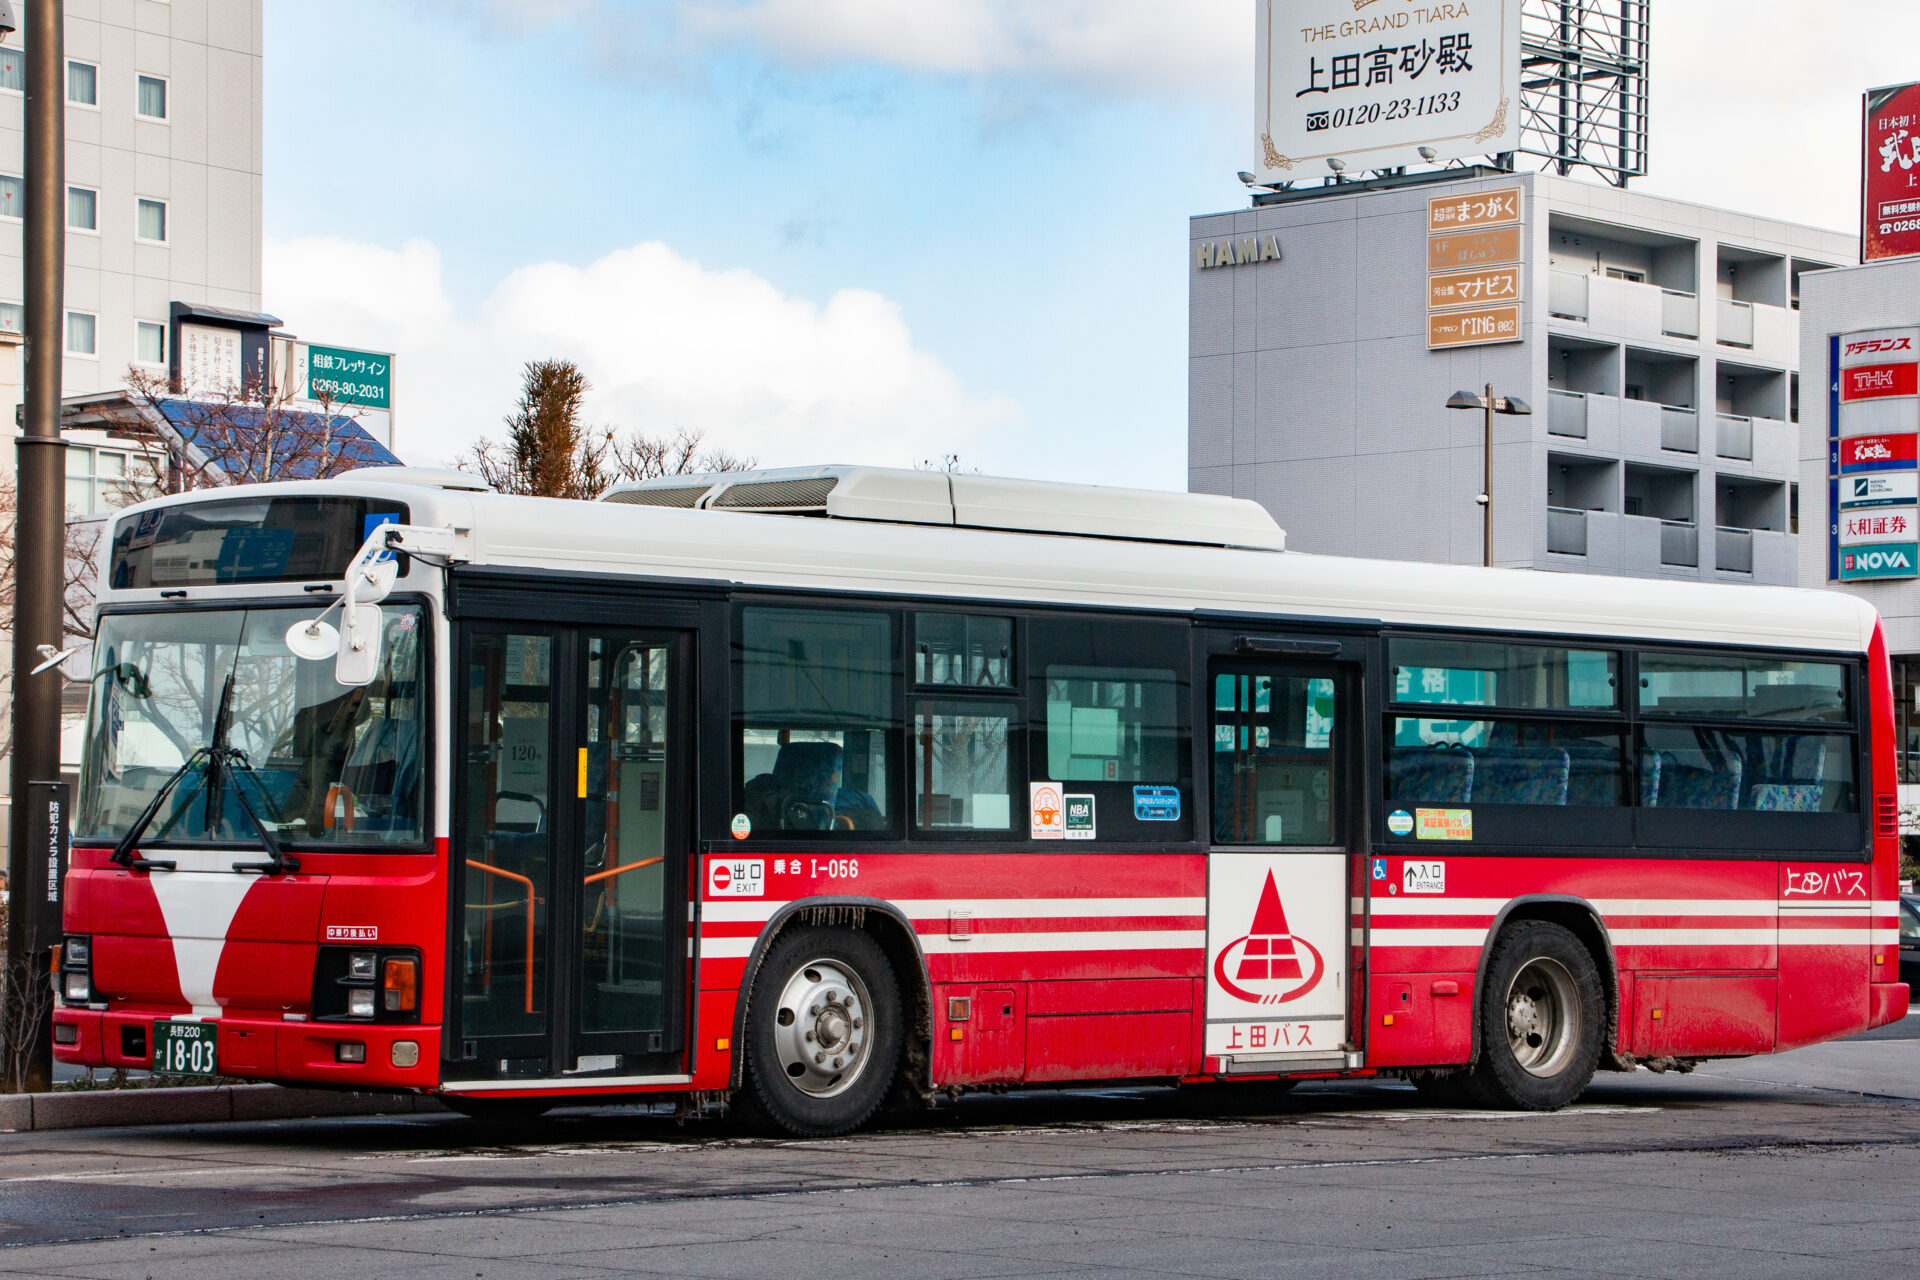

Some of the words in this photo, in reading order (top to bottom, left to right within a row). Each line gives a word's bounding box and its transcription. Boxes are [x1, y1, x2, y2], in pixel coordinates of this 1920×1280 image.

[1301, 24, 1336, 43] THE
[1340, 14, 1412, 38] GRAND
[1414, 4, 1469, 25] TIARA
[1296, 33, 1472, 98] 上田高砂殿
[1333, 91, 1461, 129] 0120-23-1133
[1878, 114, 1920, 131] 日本初！
[1905, 173, 1918, 188] 上
[1456, 197, 1515, 222] まつがく
[1197, 236, 1282, 268] HAMA
[1456, 275, 1515, 298] マナビス
[1497, 319, 1515, 332] 002
[1845, 337, 1912, 356] アデランス
[312, 353, 386, 376] 相鉄フレッサイン
[312, 378, 384, 399] 0268-80-2031
[1832, 382, 1838, 392] 4
[1854, 370, 1893, 388] THK
[1832, 453, 1838, 463] 3
[1832, 525, 1838, 534] 3
[1846, 516, 1907, 537] 大和証券
[1857, 552, 1911, 571] NOVA
[1069, 804, 1089, 816] NBA
[48, 801, 60, 902] 防犯カメラ設置区域
[733, 863, 761, 880] 出口
[774, 859, 802, 875] 乗合
[811, 859, 859, 878] I-056
[1420, 865, 1440, 879] 入口
[736, 883, 757, 892] EXIT
[1416, 881, 1444, 890] ENTRANCE
[1784, 867, 1866, 896] 上田バス
[328, 928, 376, 938] 中乗り後払い
[1226, 1023, 1312, 1049] 上田バス
